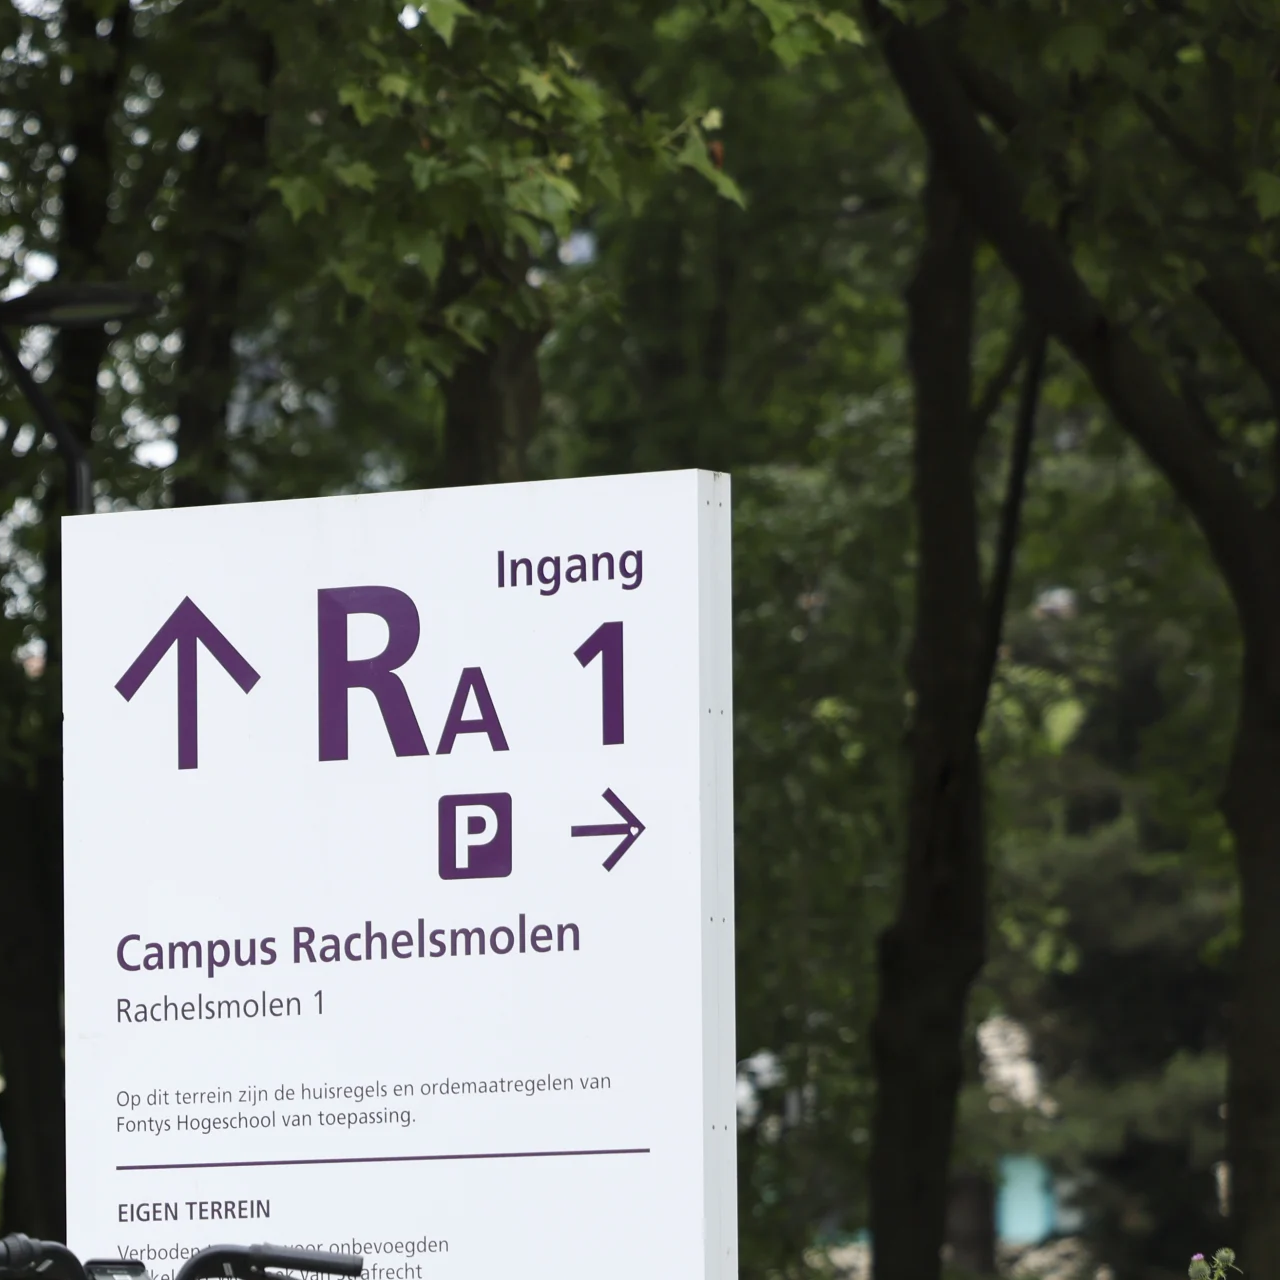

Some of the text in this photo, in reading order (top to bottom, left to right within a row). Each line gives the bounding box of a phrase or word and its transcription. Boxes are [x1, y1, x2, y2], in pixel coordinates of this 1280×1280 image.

[497, 550, 643, 597] Ingang
[572, 620, 625, 746] 1
[455, 803, 499, 869] P
[116, 913, 580, 979] Campus Rachelsmolen
[117, 989, 324, 1023] Rachelsmolen 1
[116, 1073, 611, 1111] Op dit terrein zijn de huisregels en ordemaatregelen van
[117, 1107, 416, 1137] Fontys Hogeschool van toepassing.
[118, 1199, 270, 1223] EIGEN TERREIN
[328, 1236, 449, 1258] onbevoegden
